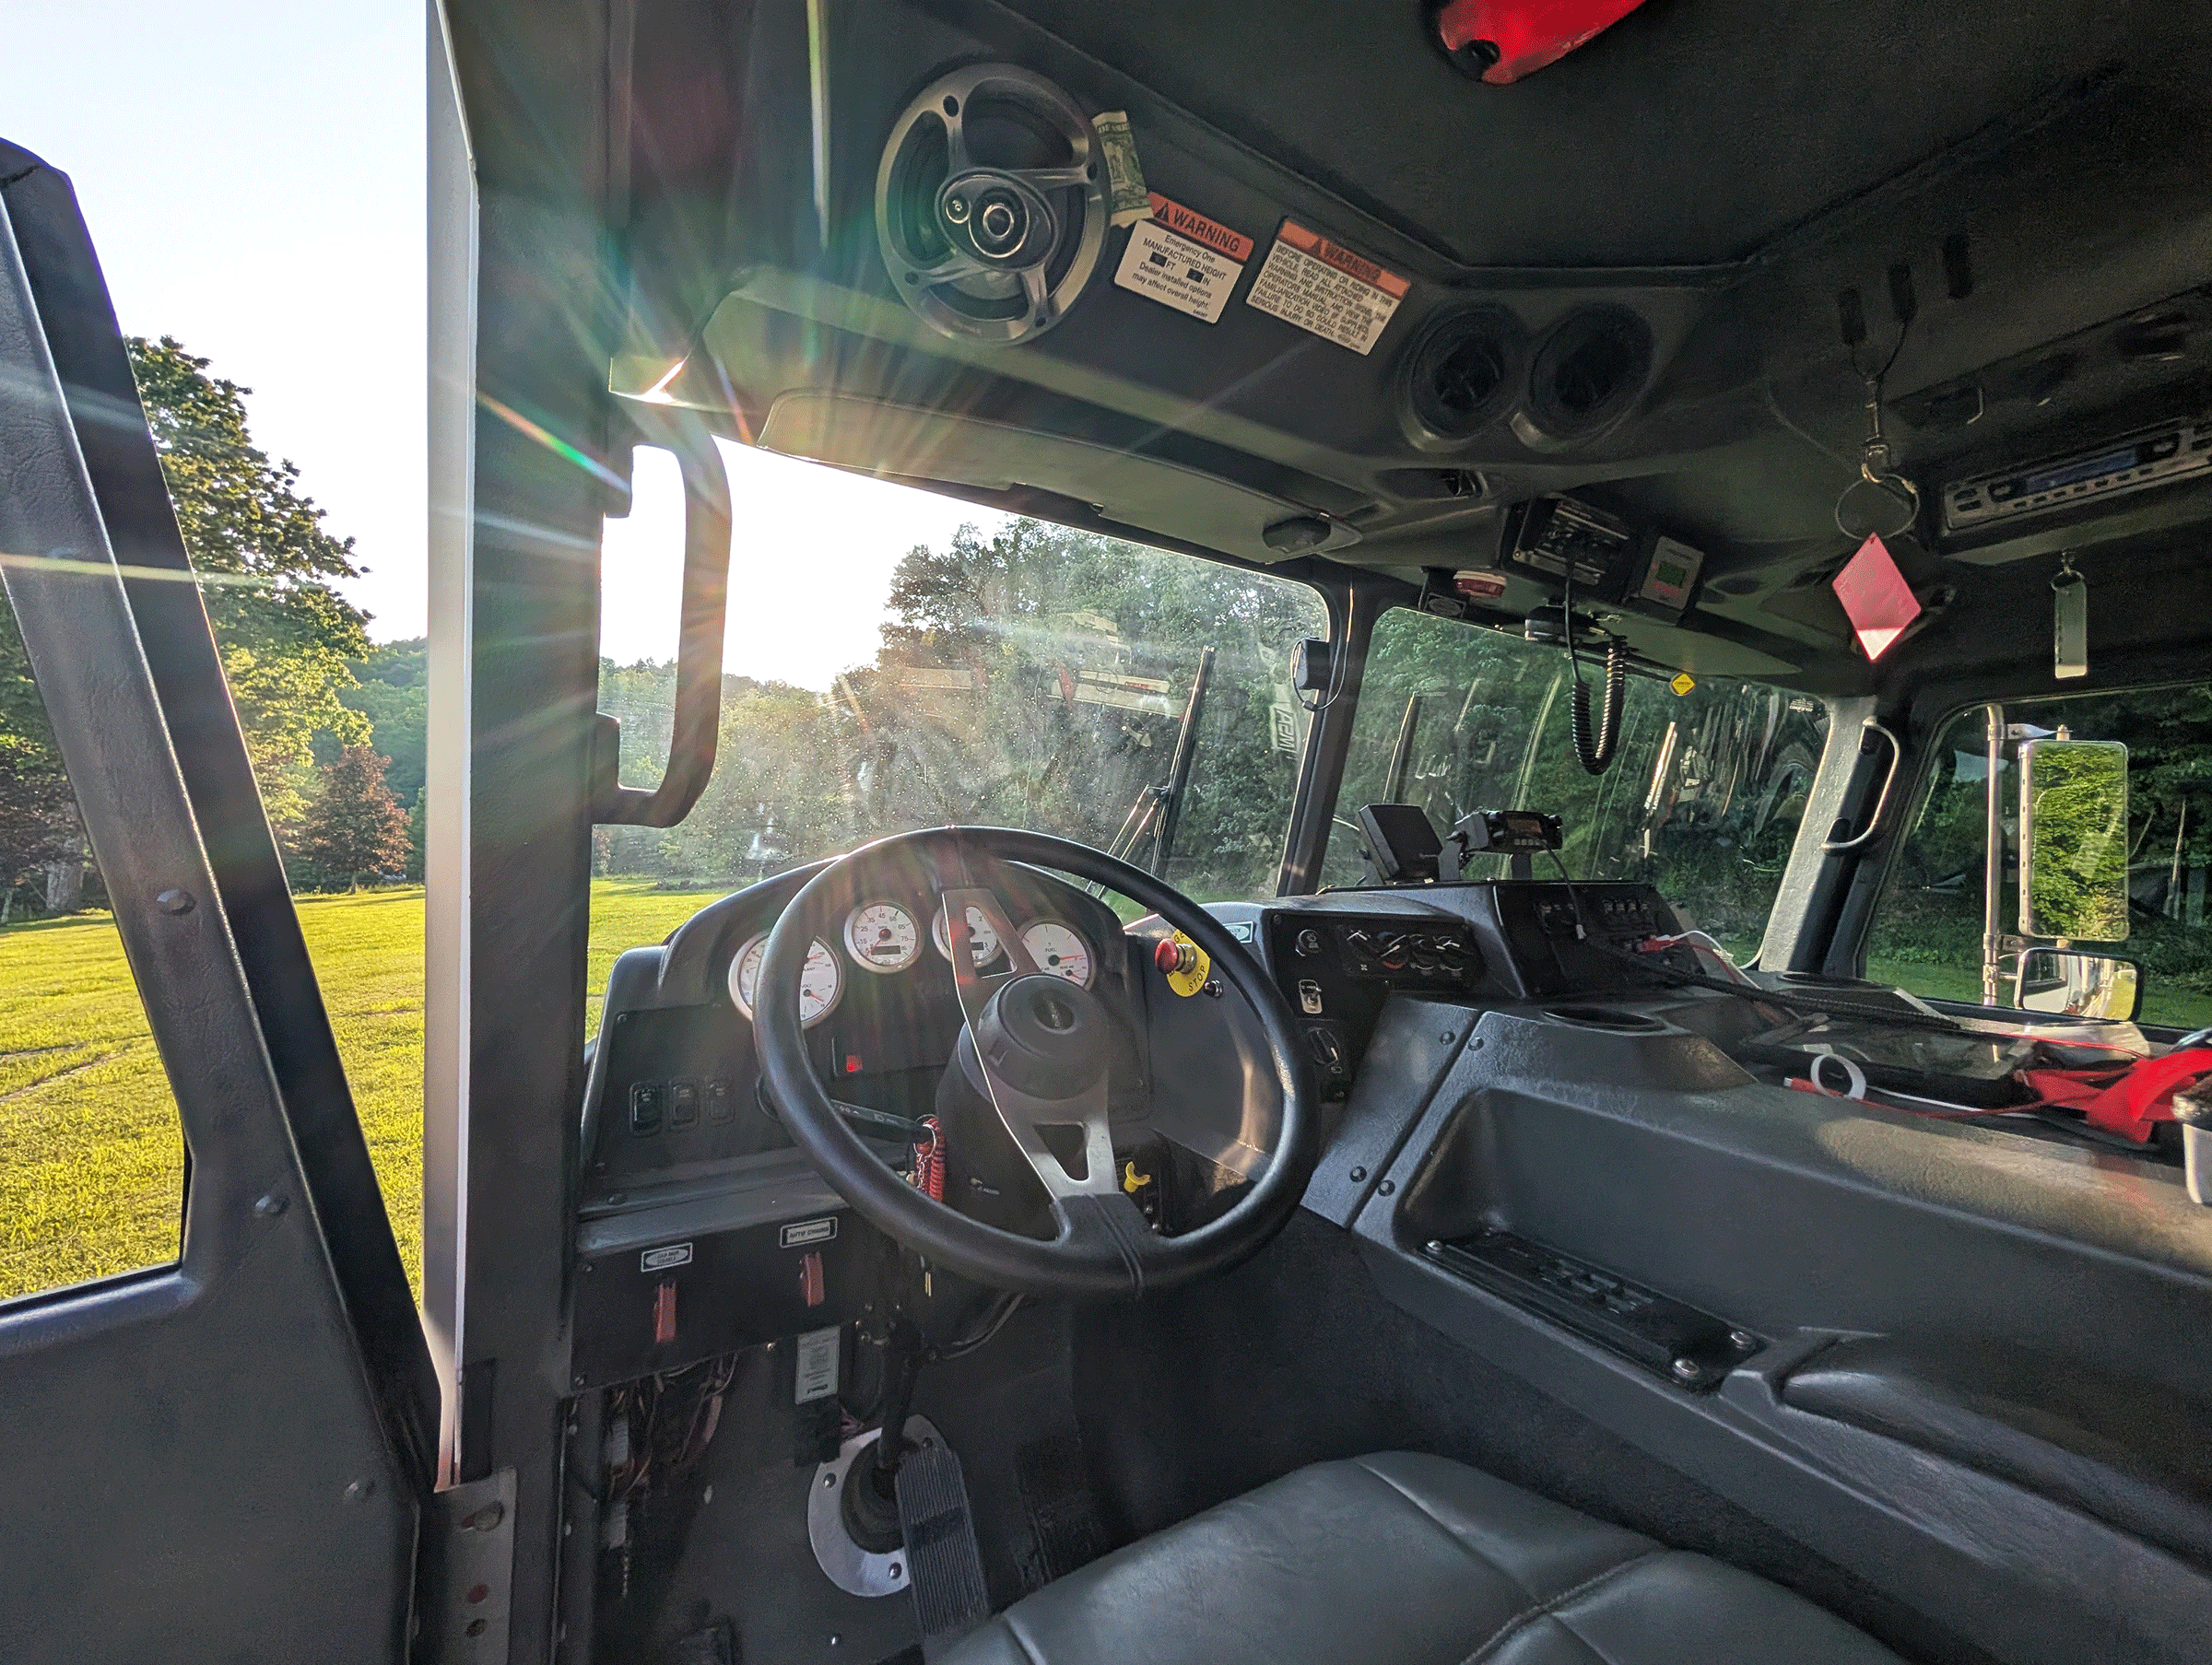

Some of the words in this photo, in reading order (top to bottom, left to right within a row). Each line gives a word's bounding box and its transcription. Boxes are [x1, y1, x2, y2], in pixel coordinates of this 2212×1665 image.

[1172, 209, 1241, 252] WARNING
[1143, 238, 1201, 269] MANUFACTURED
[1202, 264, 1226, 280] HEIGHT
[1164, 234, 1201, 258] Emergency
[1202, 251, 1216, 264] One
[1276, 244, 1301, 263] BEFORE
[1303, 257, 1337, 280] OPERATING
[1339, 275, 1348, 286] OR
[1132, 273, 1146, 285] may
[1147, 277, 1166, 291] affect
[1167, 286, 1188, 300] overall
[1139, 262, 1160, 276] Dealer
[1161, 271, 1188, 288] installed
[1189, 284, 1211, 300] options
[1166, 260, 1175, 270] FT
[1203, 276, 1209, 286] IN
[1301, 266, 1319, 281] READ
[1321, 276, 1332, 287] ALL
[1334, 282, 1363, 302] ATTACHED
[1255, 286, 1280, 304] FAILURE
[1283, 299, 1291, 309] TO
[1293, 303, 1303, 314] DO
[1305, 309, 1314, 319] SO
[1316, 313, 1336, 329] COULD
[1260, 276, 1310, 308] FAMILIARIZATION
[1312, 301, 1329, 316] VIDEO
[1299, 276, 1312, 288] AND
[1314, 283, 1353, 308] INSTRUCTION
[1330, 301, 1343, 312] AND
[1251, 293, 1277, 313] SERIOUS
[1280, 307, 1300, 322] INJURY
[1303, 317, 1312, 328] OR
[1187, 965, 1206, 992] STOP
[789, 1229, 806, 1239] AUTO
